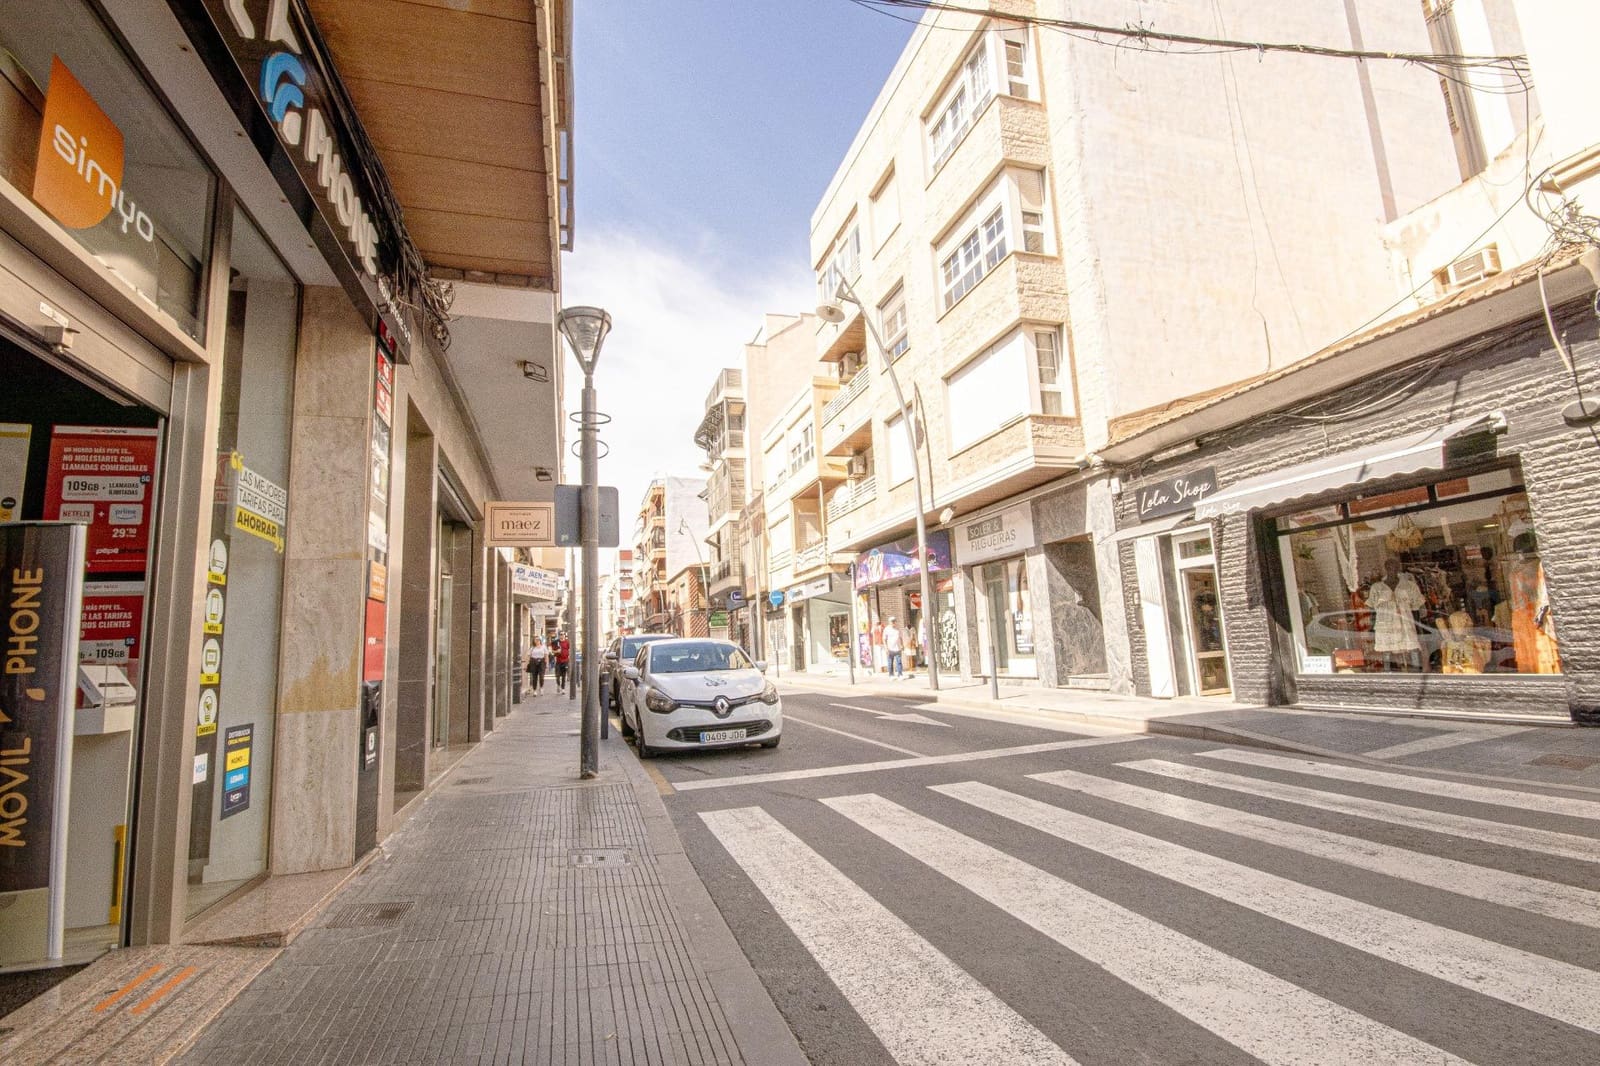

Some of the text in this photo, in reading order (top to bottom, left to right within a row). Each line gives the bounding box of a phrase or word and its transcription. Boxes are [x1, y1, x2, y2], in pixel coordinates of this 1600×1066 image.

[53, 124, 154, 242] simyo
[1140, 479, 1211, 515] Lola Shop
[237, 511, 277, 538] AHORRAR
[501, 520, 541, 530] maez
[970, 529, 1017, 552] FILGUEIRAS
[6, 567, 43, 674] PHONE
